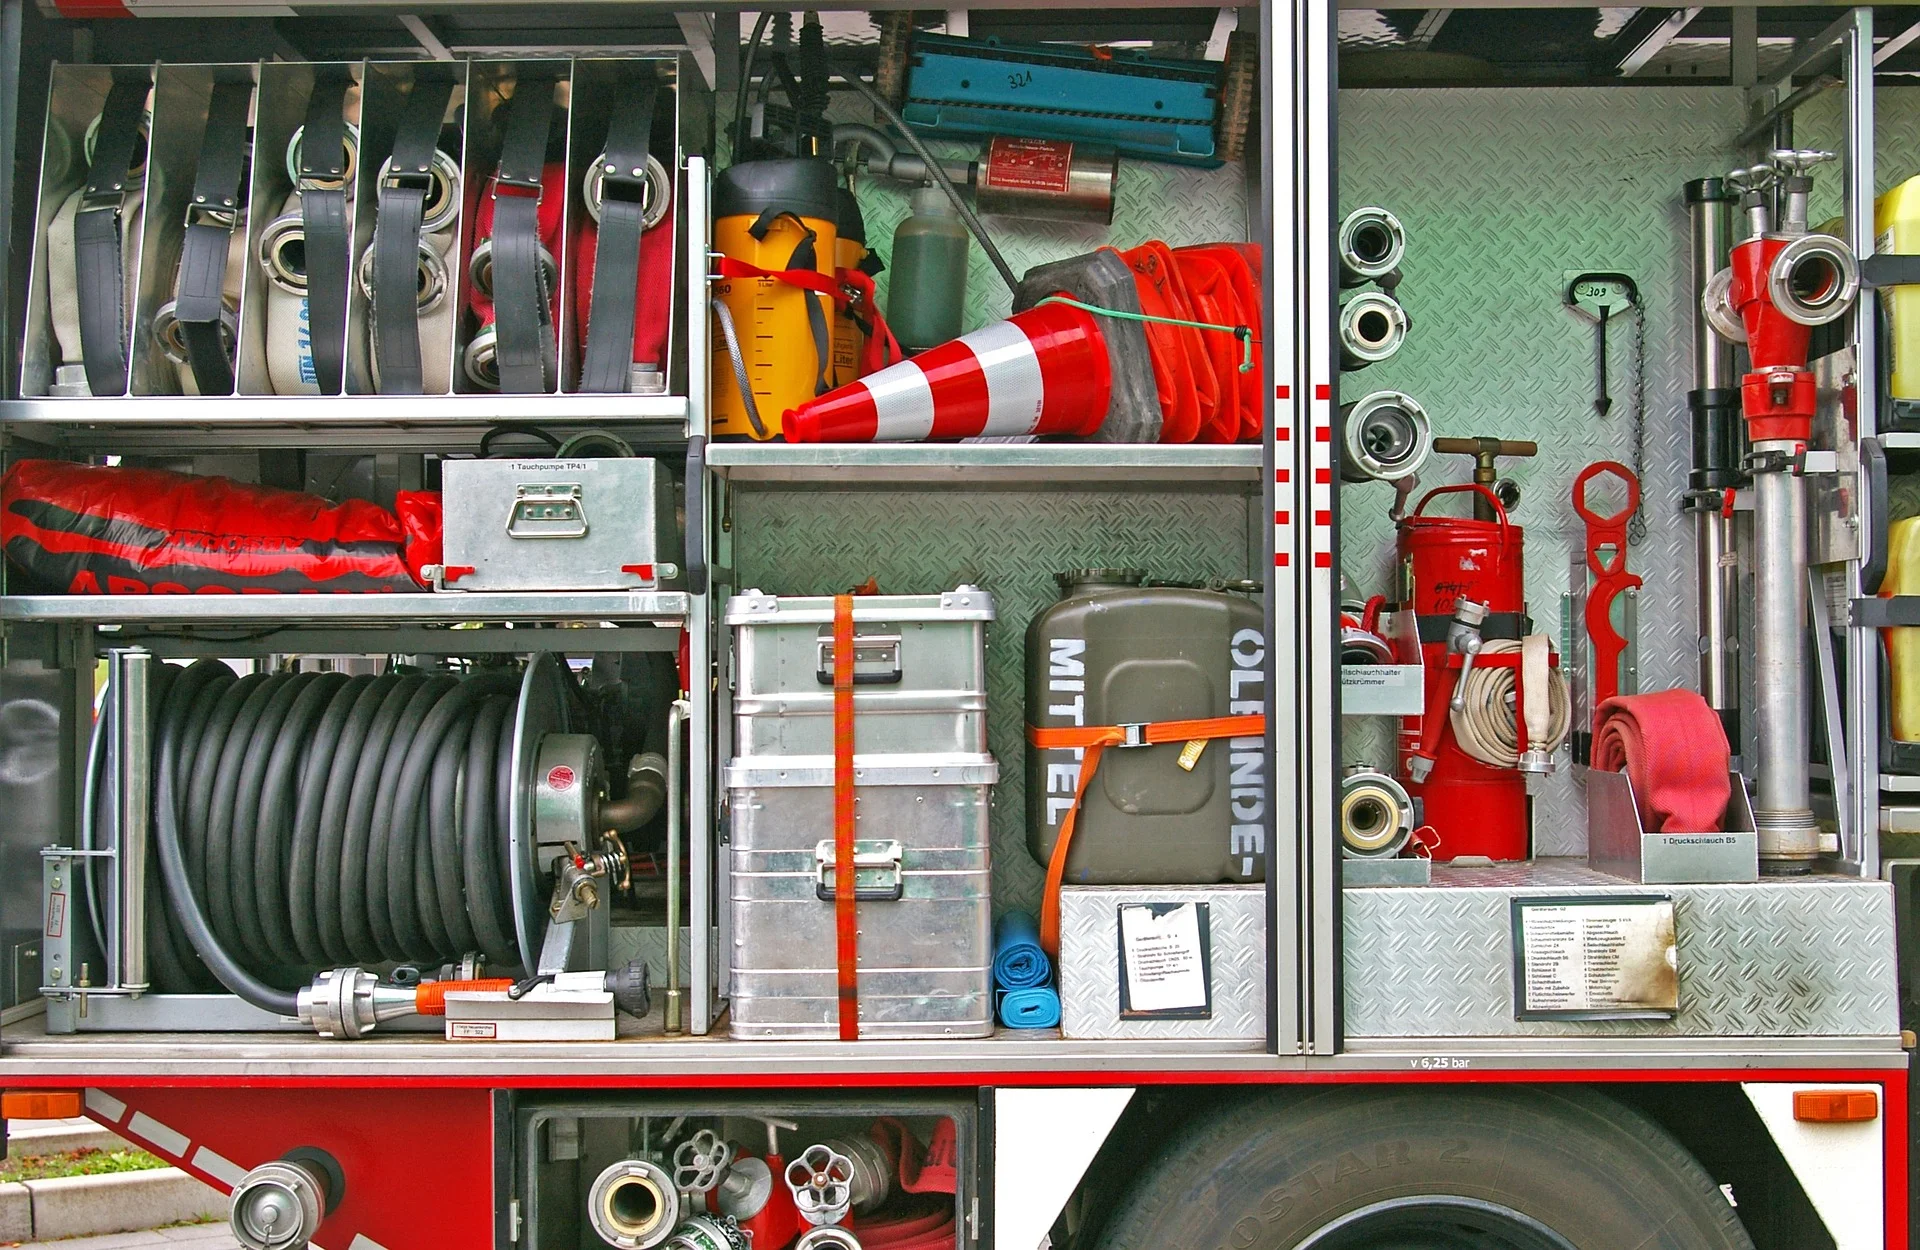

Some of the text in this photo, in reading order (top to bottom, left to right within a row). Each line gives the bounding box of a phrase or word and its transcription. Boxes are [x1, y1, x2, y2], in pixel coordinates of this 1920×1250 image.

[1007, 70, 1032, 89] 321
[1586, 287, 1607, 297] 309
[517, 463, 565, 471] Tauchpumpe
[1669, 837, 1724, 845] Druckschlauch
[1421, 1057, 1449, 1070] 6,25
[1451, 1057, 1470, 1068] bar
